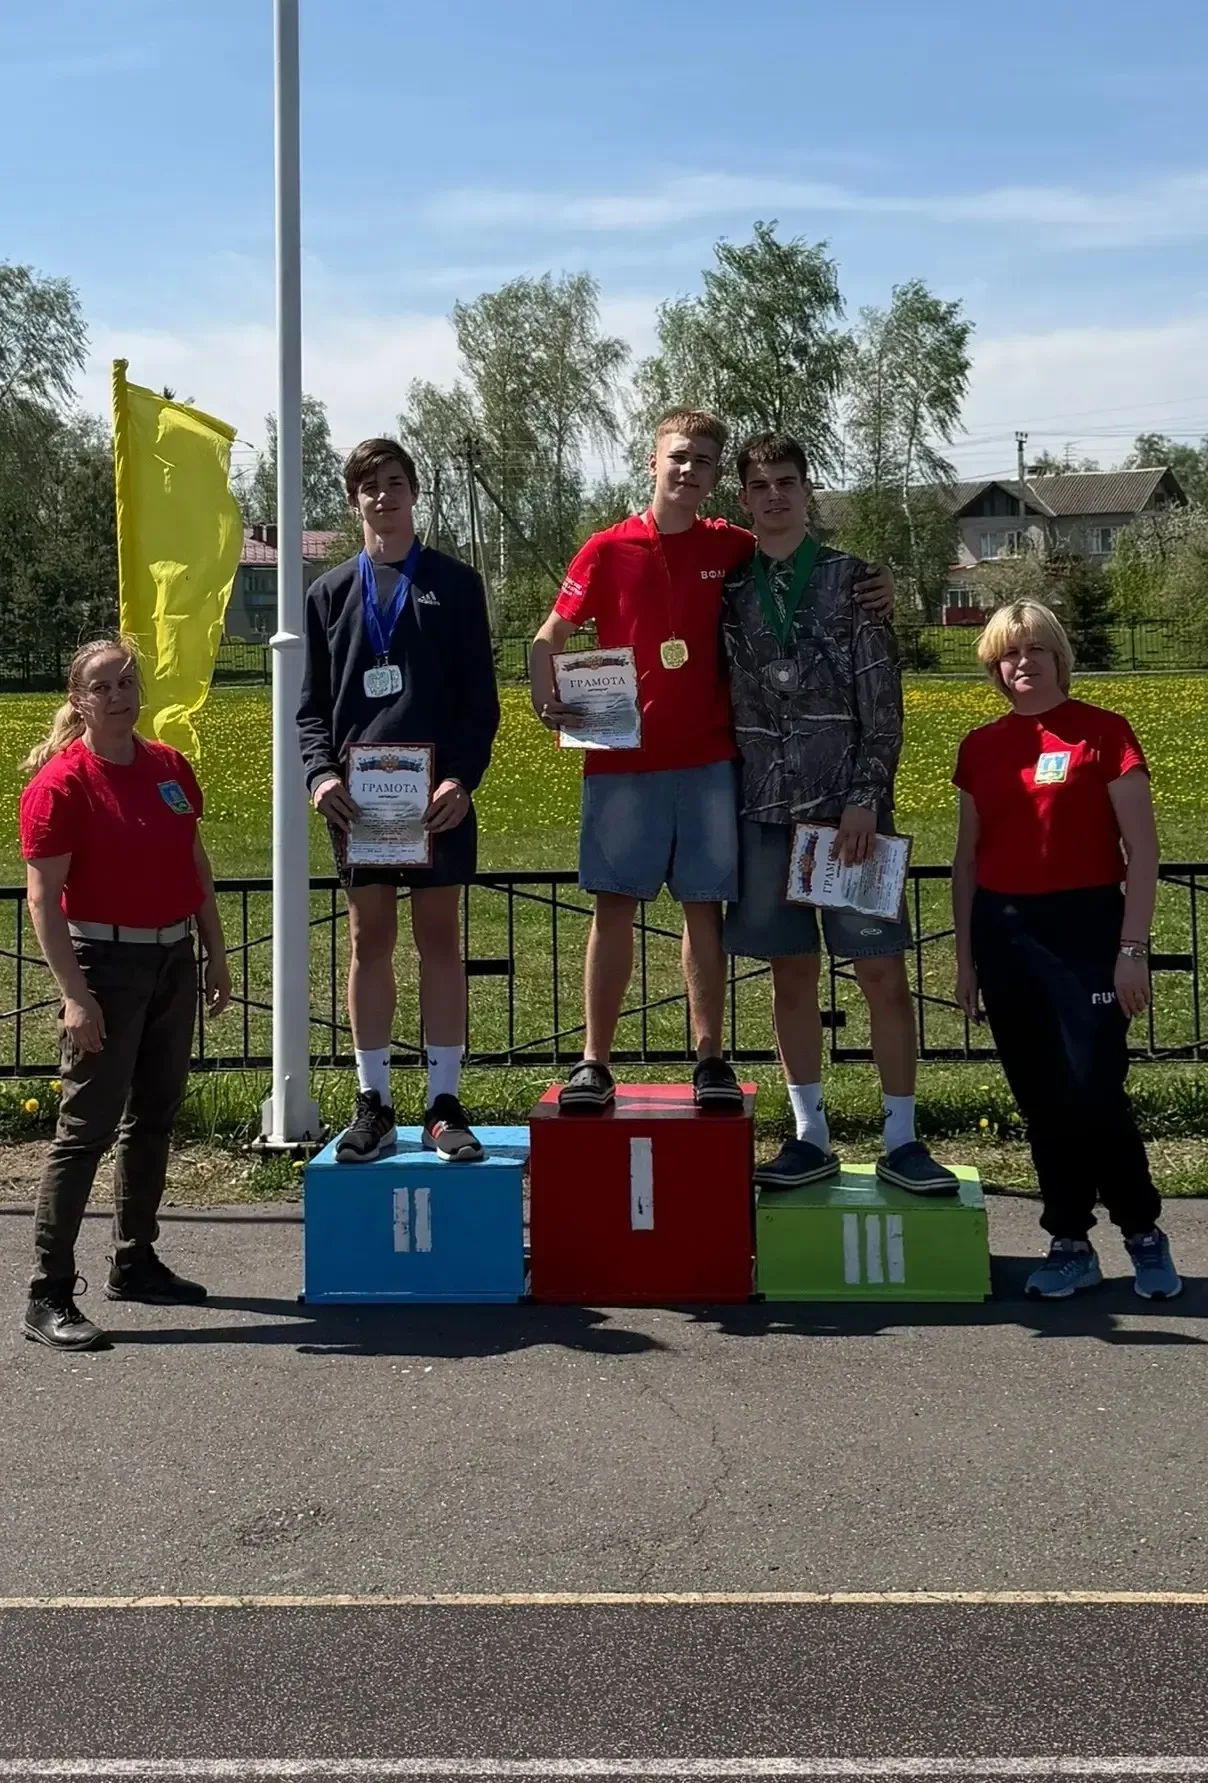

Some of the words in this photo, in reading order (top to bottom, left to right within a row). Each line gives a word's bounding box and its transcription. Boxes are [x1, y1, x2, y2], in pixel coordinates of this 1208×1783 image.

[570, 676, 626, 688] ГРАМОТА
[362, 783, 418, 793] ГРАМОТА
[822, 841, 837, 894] ГРАМО
